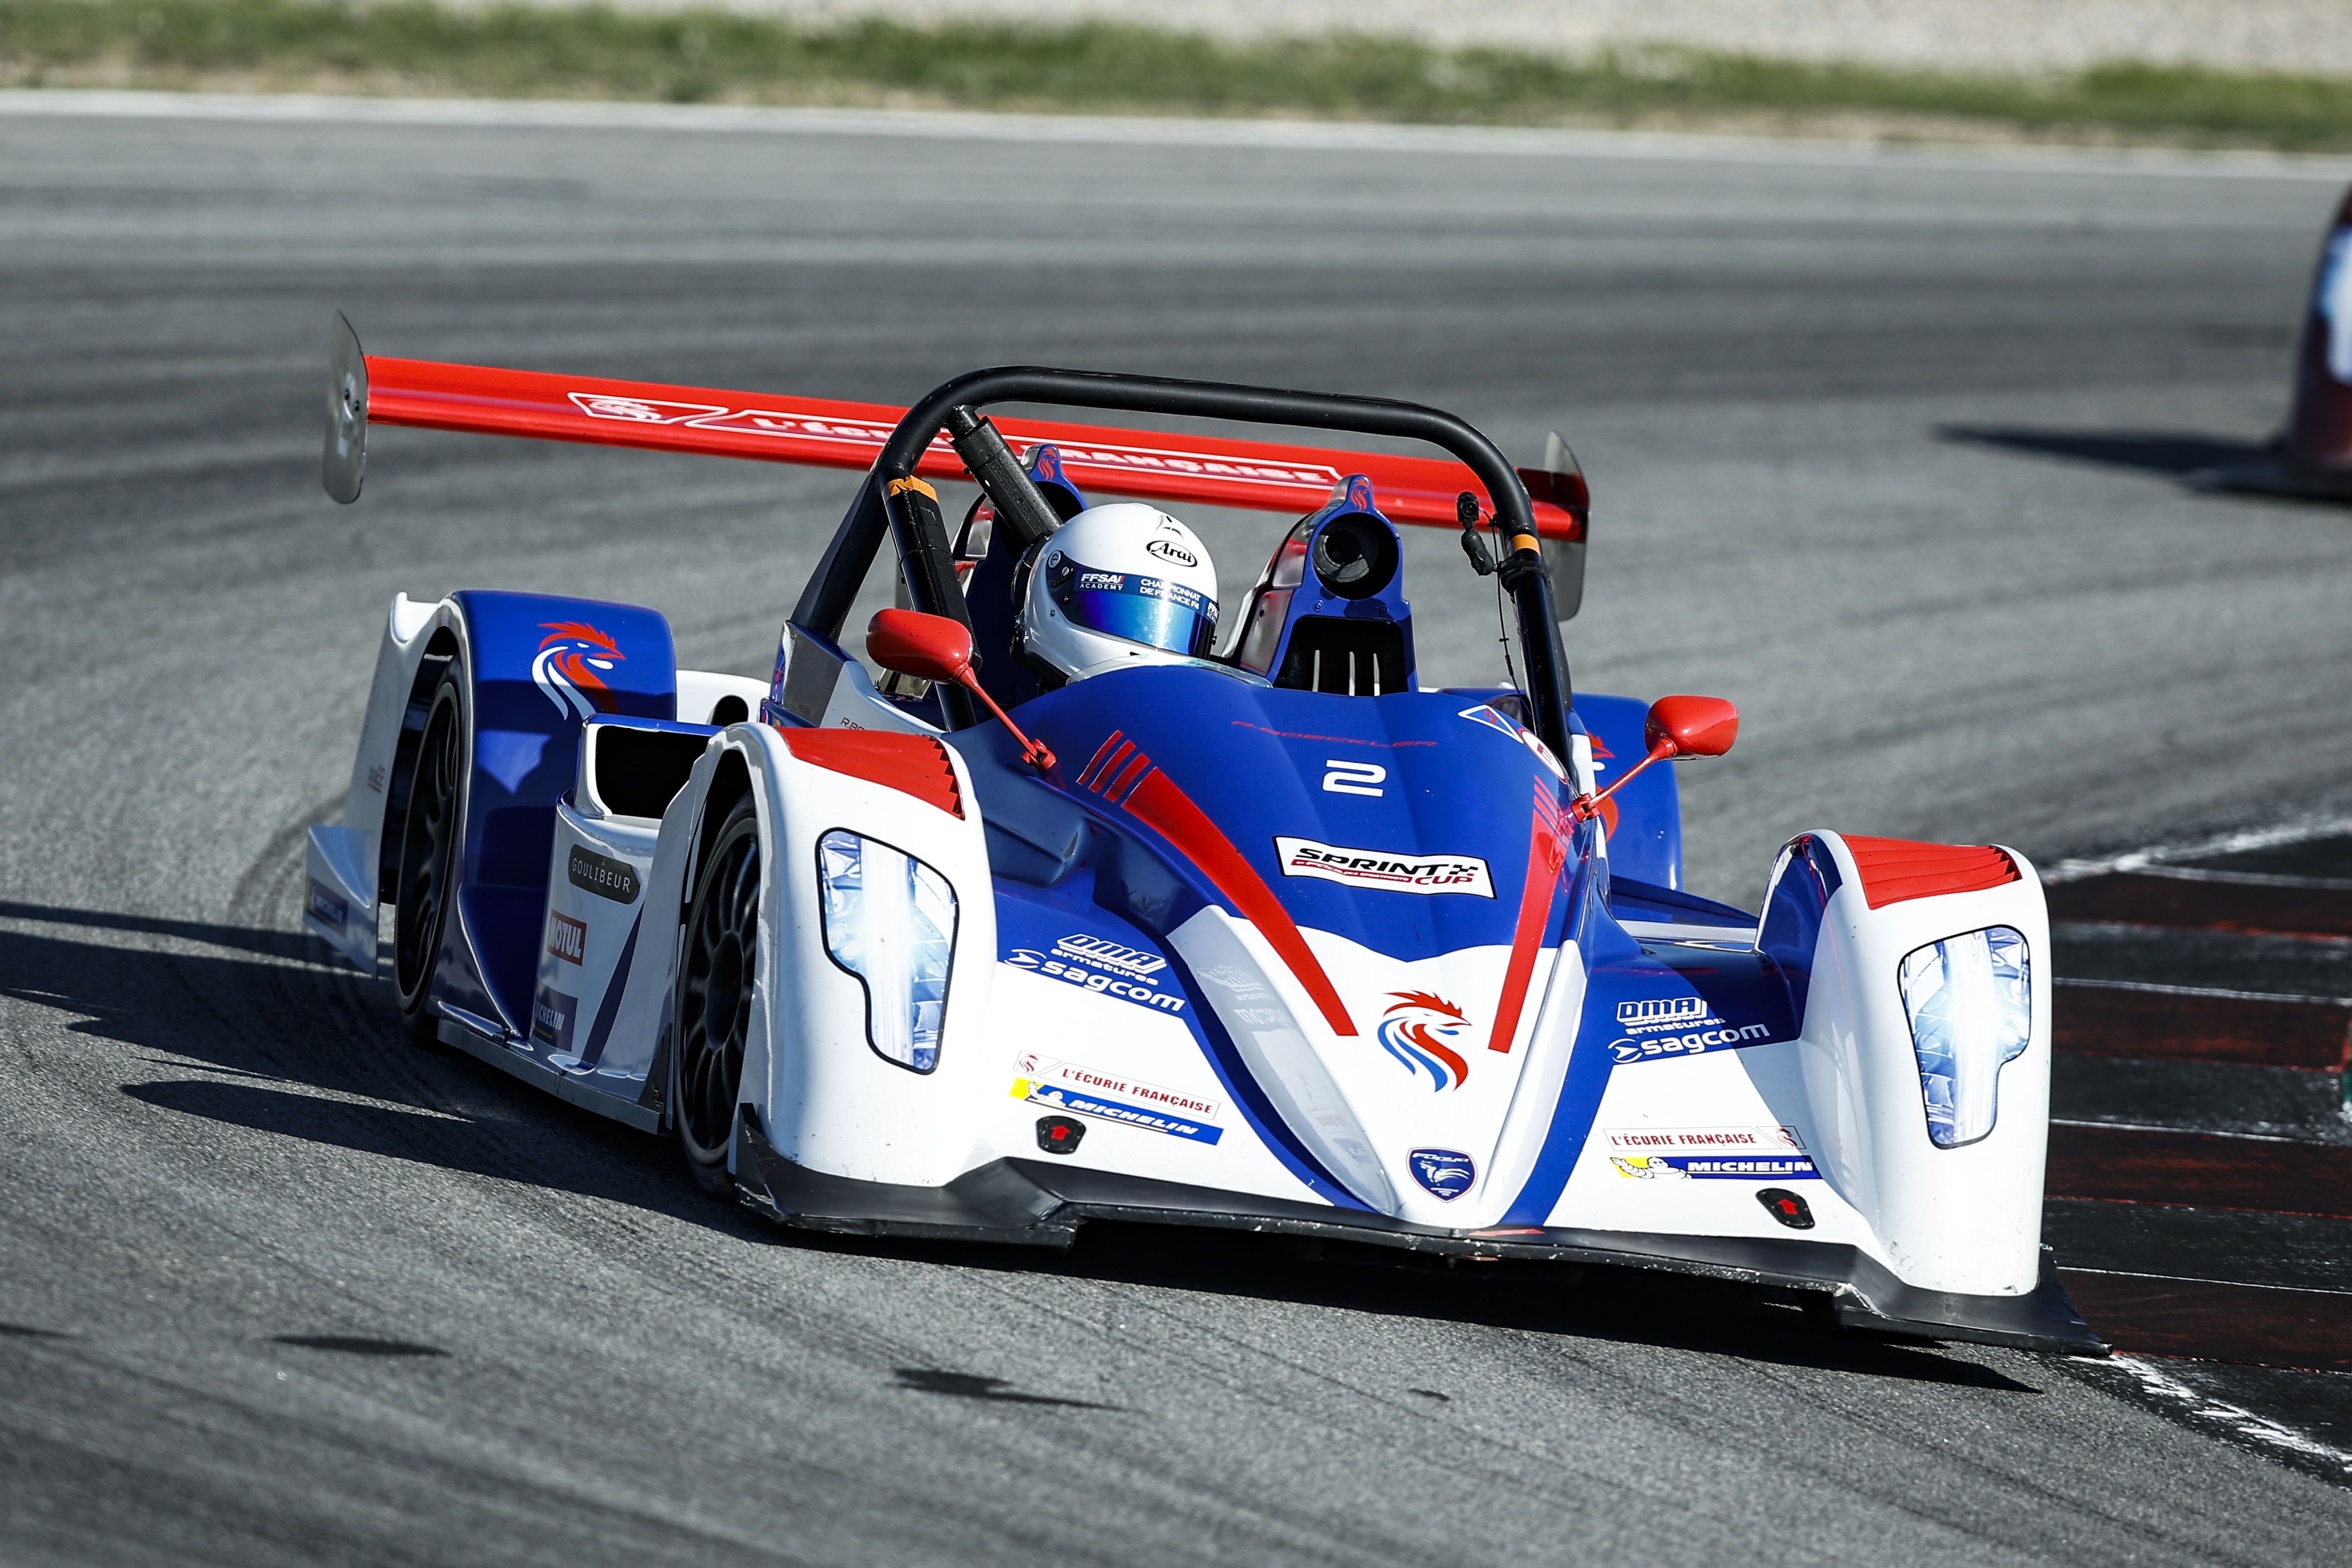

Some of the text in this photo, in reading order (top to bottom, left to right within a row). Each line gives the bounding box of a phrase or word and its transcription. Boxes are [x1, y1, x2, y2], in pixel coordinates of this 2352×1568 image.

[1020, 445, 1329, 483] RANÇAISE
[1151, 542, 1192, 563] Arai
[1139, 587, 1154, 595] DE
[1191, 600, 1200, 610] F4
[1322, 759, 1386, 796] 2
[572, 858, 630, 893] GOULIBEUR
[1415, 876, 1473, 885] CUP
[548, 916, 582, 958] MOTUL
[1050, 948, 1159, 986] armatures
[1041, 961, 1185, 1011] sagcom
[1625, 1018, 1726, 1035] armatures
[1640, 1024, 1771, 1055] sagcom
[1062, 1068, 1213, 1114] L'ÉCURIE FRANÇAISE
[1068, 1099, 1200, 1135] MICHELIN
[1611, 1133, 1757, 1146] L'ÉCURIE FRANÇAISE
[1687, 1162, 1813, 1171] MICHELIN
